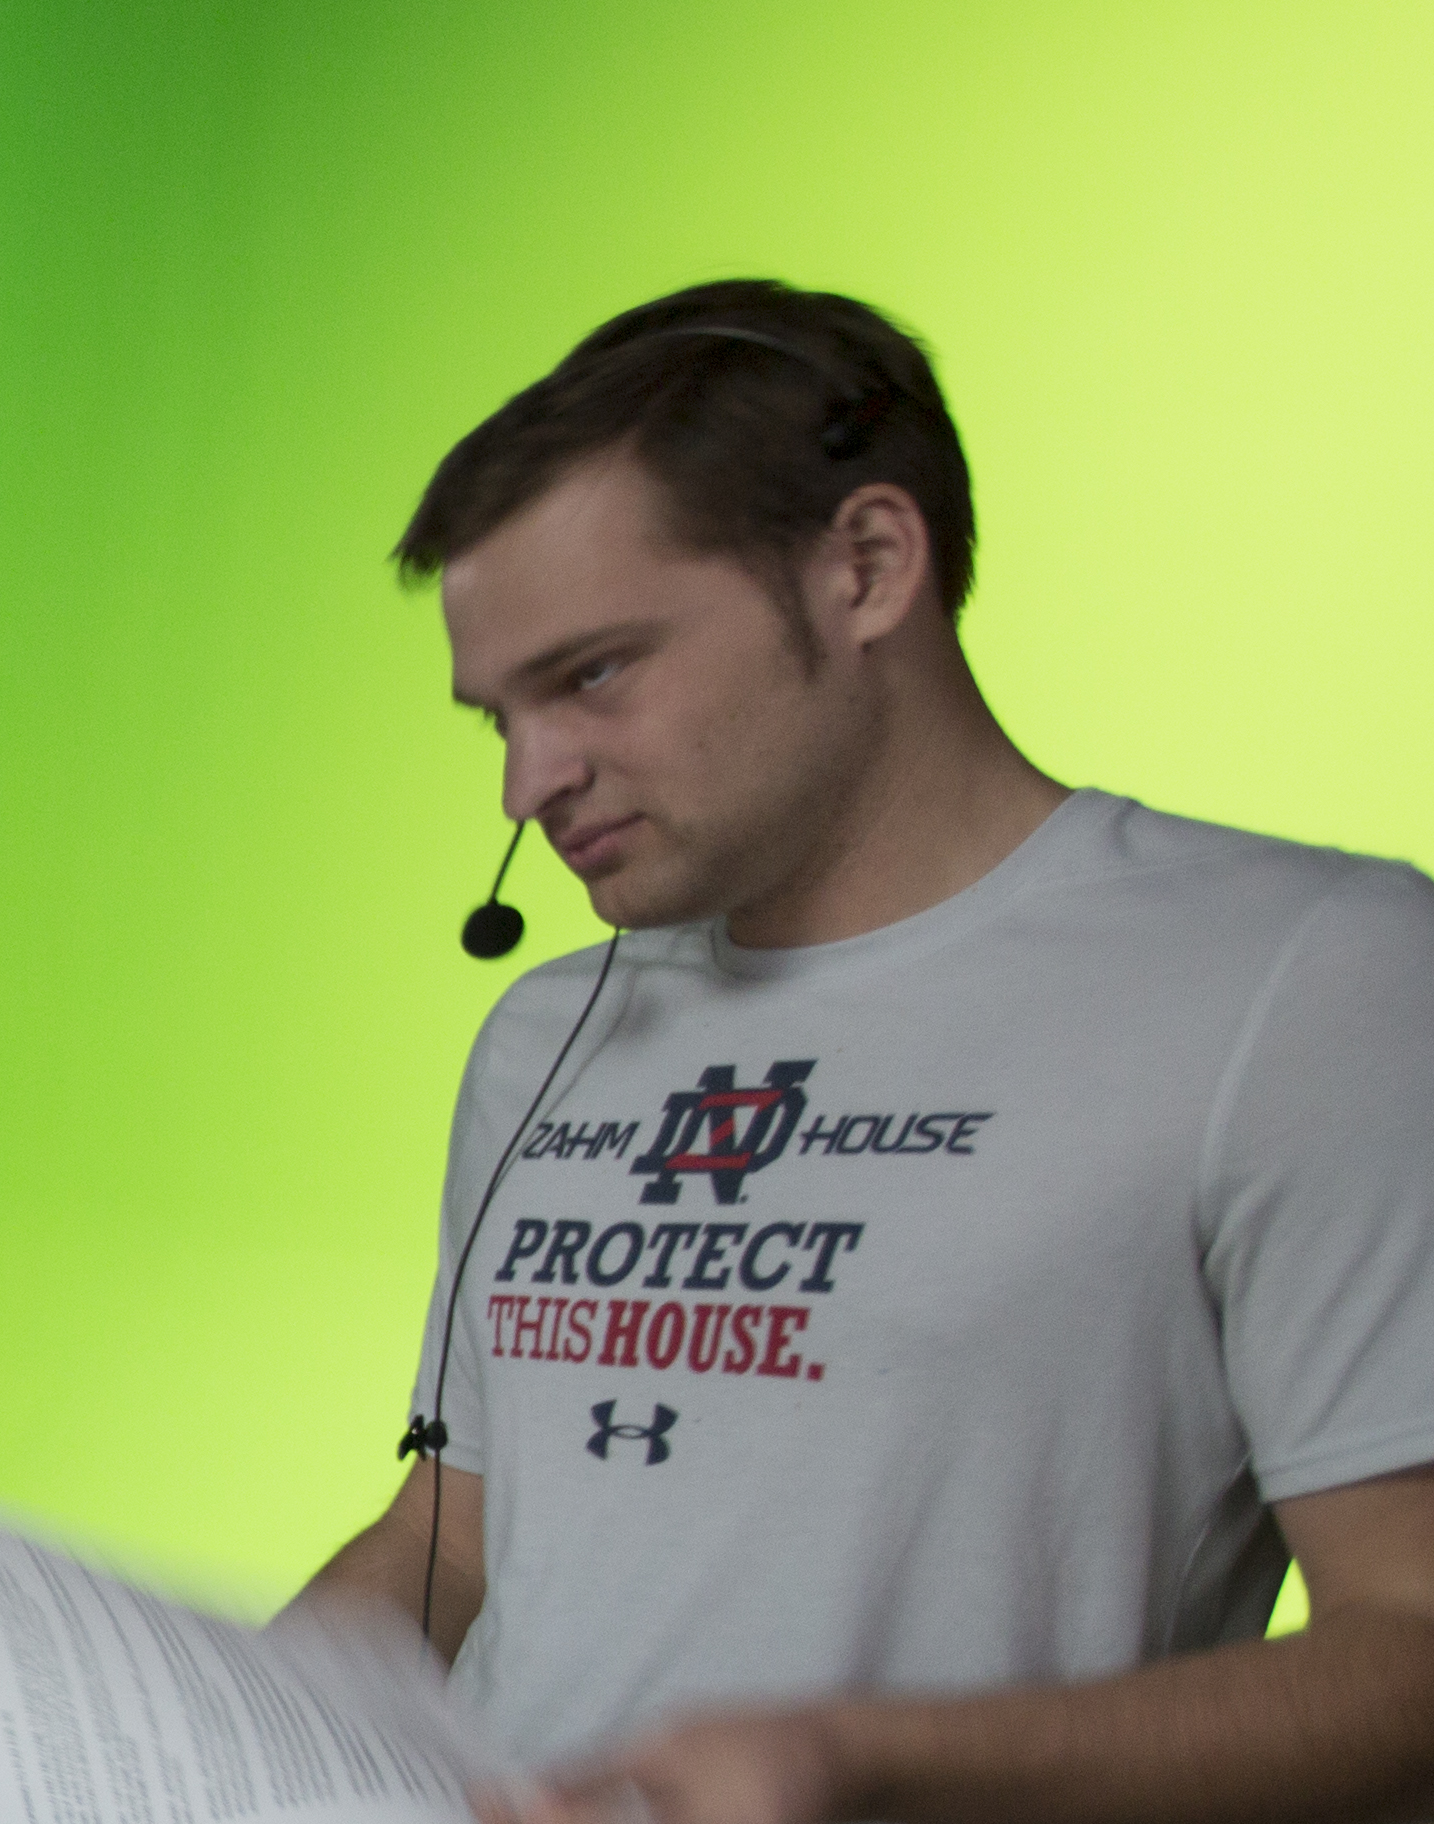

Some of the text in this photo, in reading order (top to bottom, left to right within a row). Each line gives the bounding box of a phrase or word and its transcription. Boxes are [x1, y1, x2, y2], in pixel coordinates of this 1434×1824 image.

[521, 1121, 640, 1159] ZAHM
[798, 1111, 995, 1156] HOUSE
[495, 1218, 866, 1294] PROTECT
[487, 1294, 825, 1382] THIS HOUSE.
